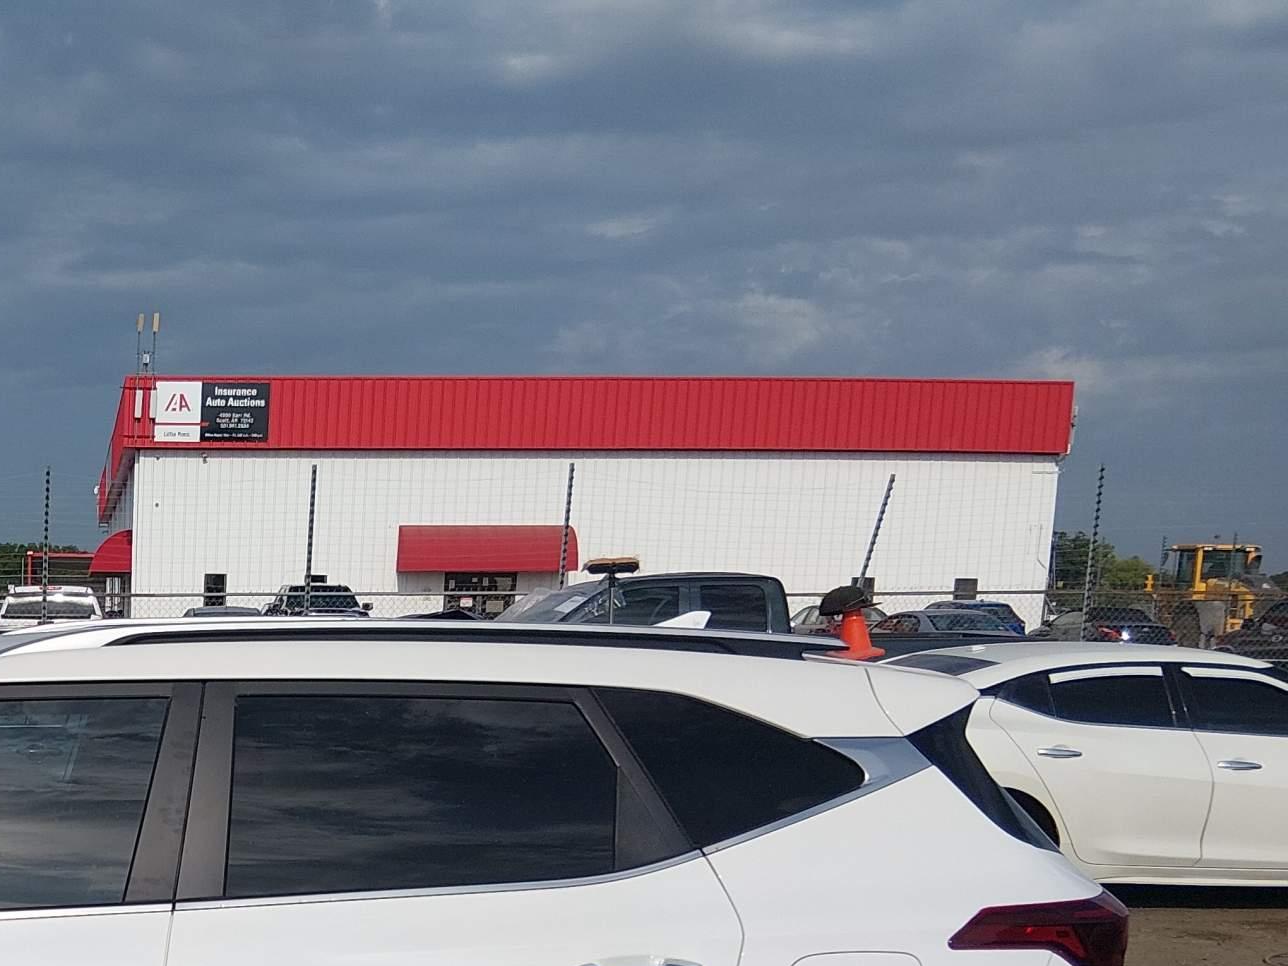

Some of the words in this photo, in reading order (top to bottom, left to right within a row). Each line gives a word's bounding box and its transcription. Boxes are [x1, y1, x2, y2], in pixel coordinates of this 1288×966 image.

[214, 386, 258, 396] Insurance
[205, 397, 226, 407] Auto
[227, 397, 266, 408] Auctions
